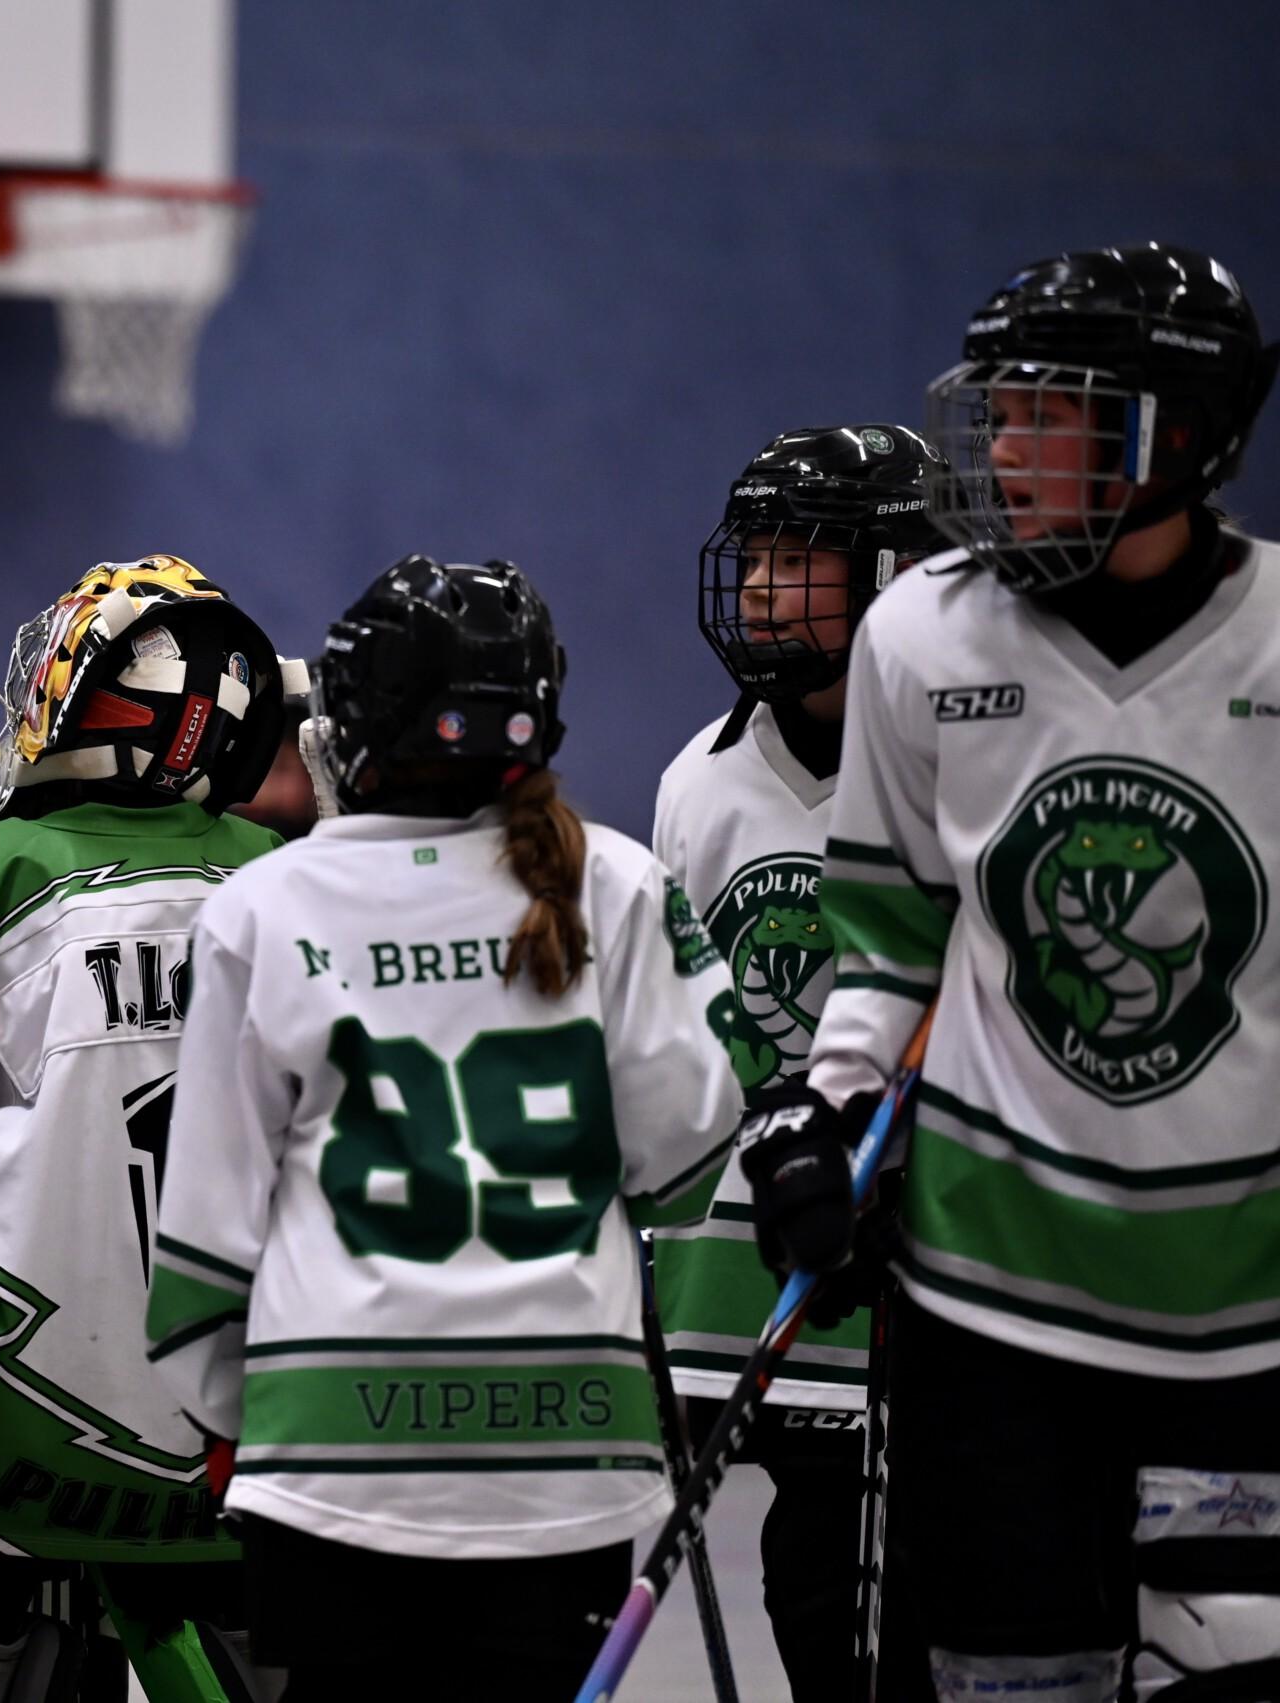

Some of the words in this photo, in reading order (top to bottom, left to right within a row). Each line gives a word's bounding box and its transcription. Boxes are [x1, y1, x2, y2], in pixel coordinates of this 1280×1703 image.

[734, 486, 779, 498] BAUER
[876, 499, 929, 516] BAUER
[175, 703, 204, 762] ITECH
[1032, 776, 1199, 834] PULHEIM
[1062, 1022, 1180, 1087] VIPERS
[320, 1015, 621, 1263] 89
[357, 1378, 611, 1430] VIPERS
